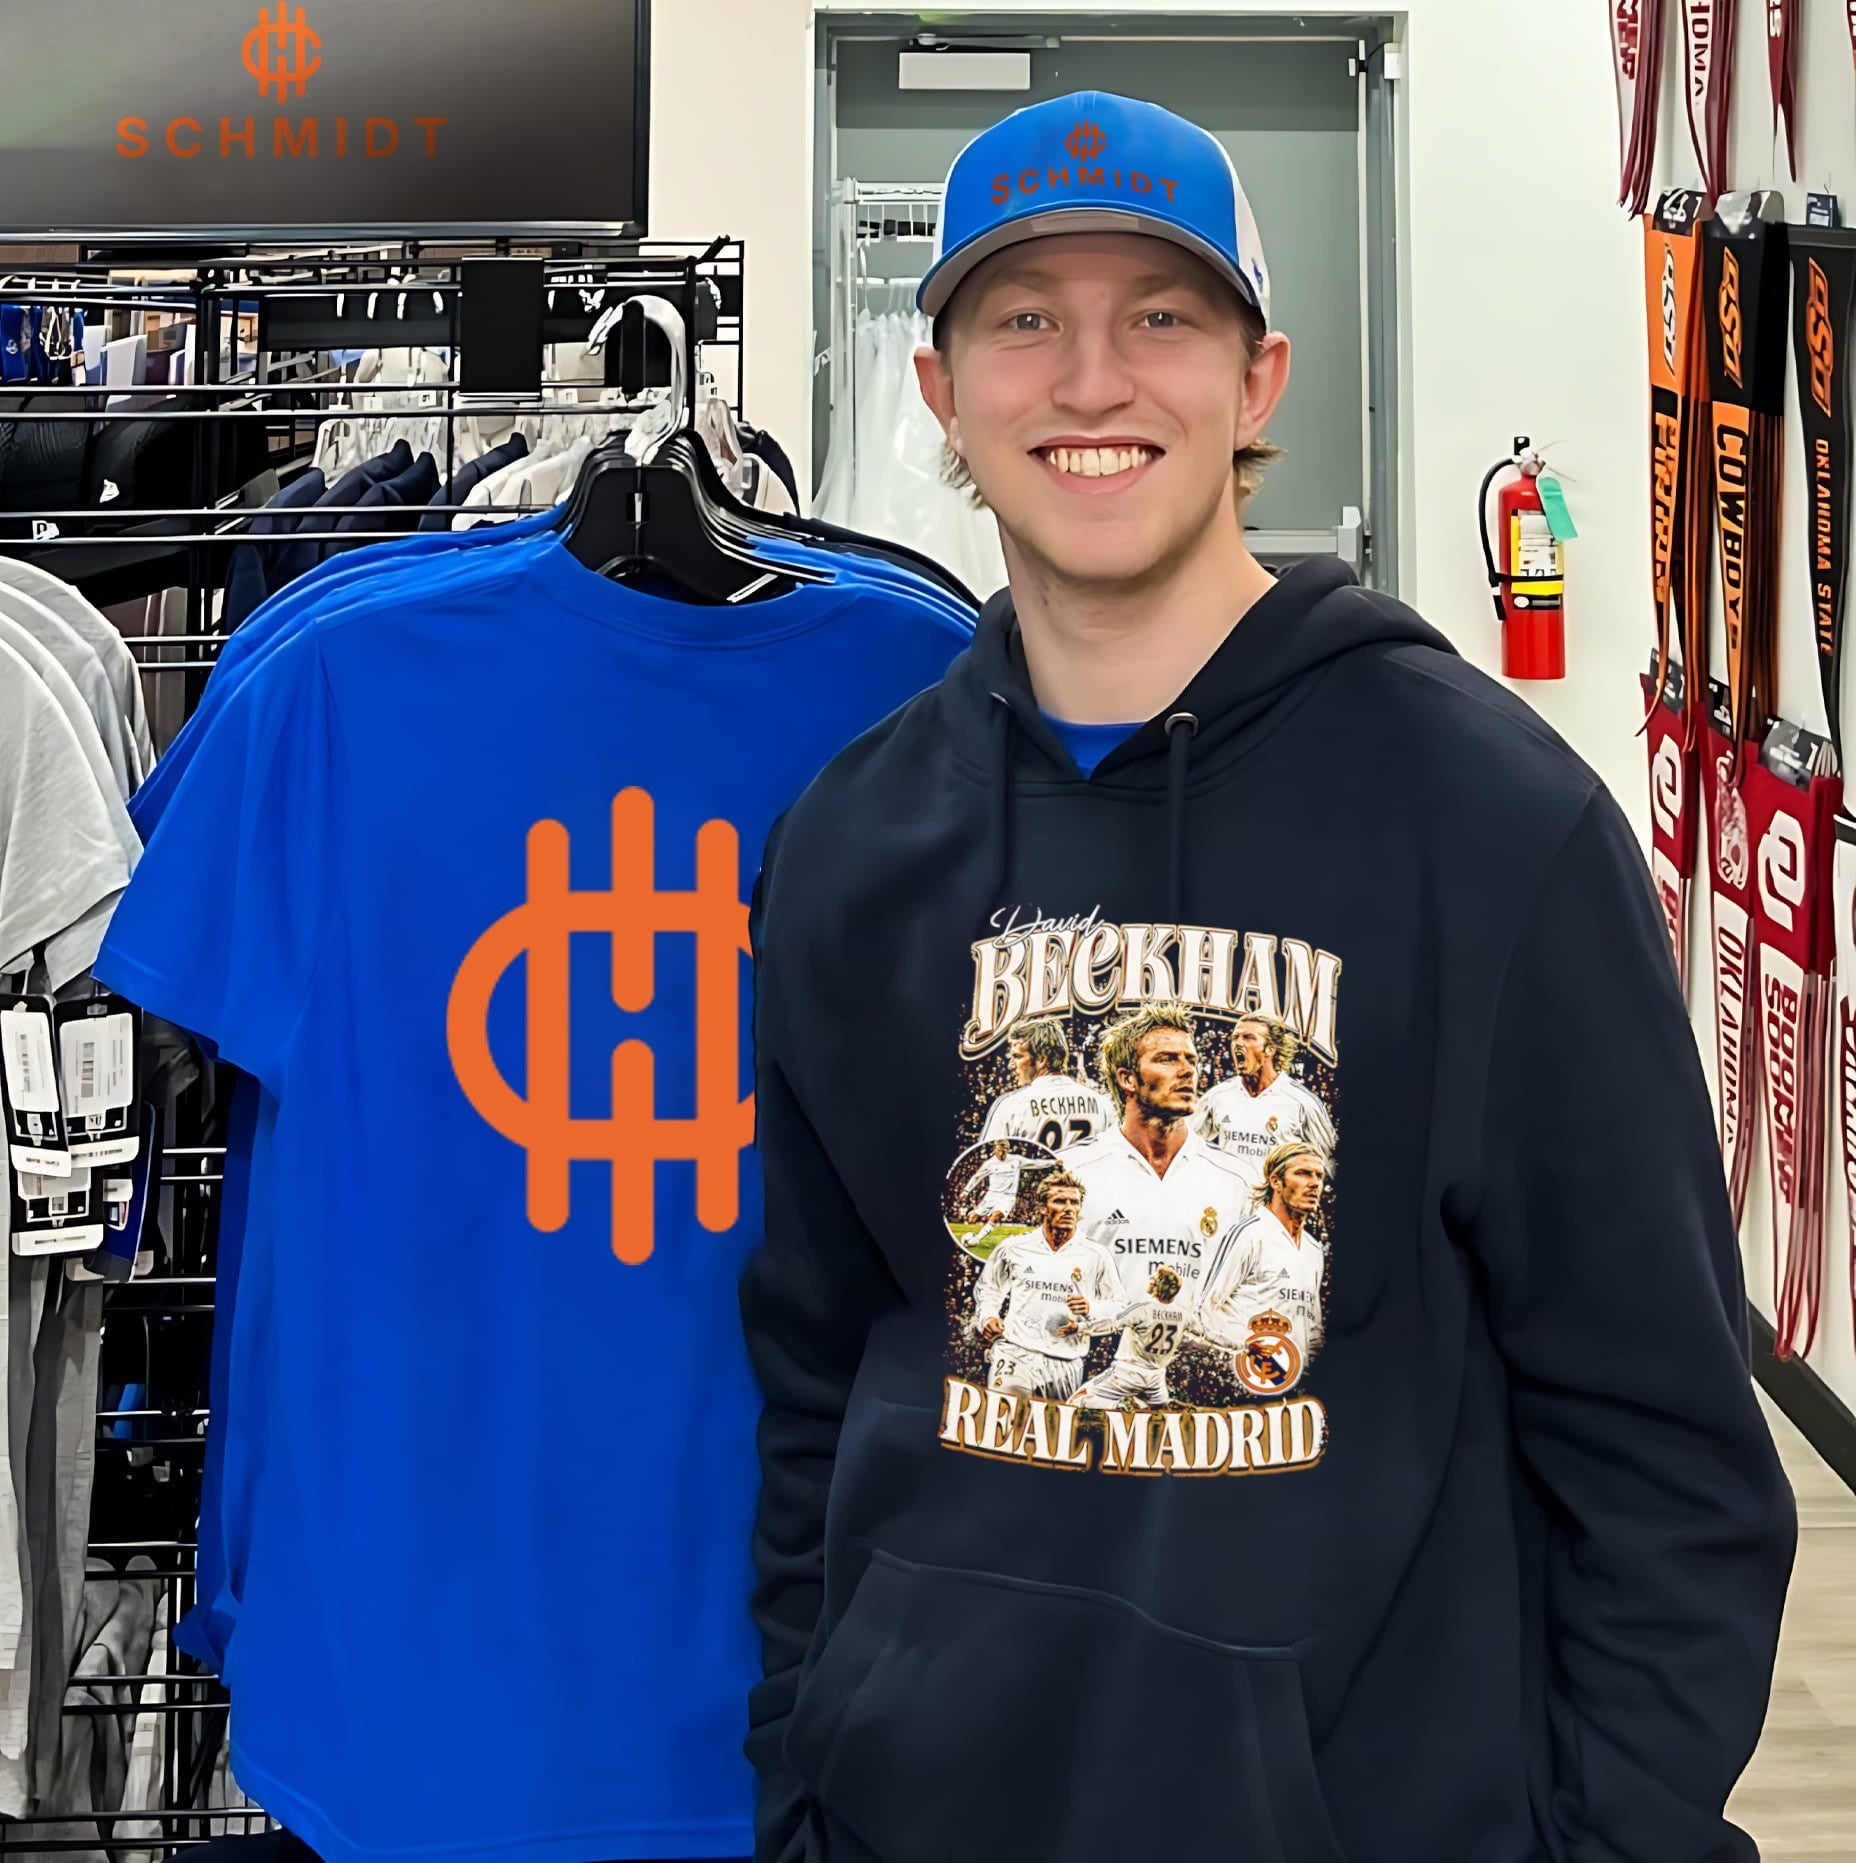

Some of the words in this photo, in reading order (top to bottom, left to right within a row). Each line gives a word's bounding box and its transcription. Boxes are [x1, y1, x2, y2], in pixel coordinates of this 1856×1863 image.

[115, 117, 447, 158] SCHMIDT
[991, 166, 1180, 205] SCHMIDT
[1815, 438, 1832, 571] OKLAHOMA
[989, 903, 1105, 949] David
[959, 922, 1342, 1069] BECKHAM
[1030, 1095, 1099, 1118] BECKHAM
[1223, 1130, 1277, 1147] SIEMENS
[1114, 1237, 1202, 1258] SIEMENS
[1025, 1280, 1074, 1293] SIEMENS
[1144, 1322, 1178, 1355] 23
[994, 1358, 1017, 1377] 23
[940, 1376, 1090, 1470] REAL
[1103, 1398, 1327, 1474] MADRID
